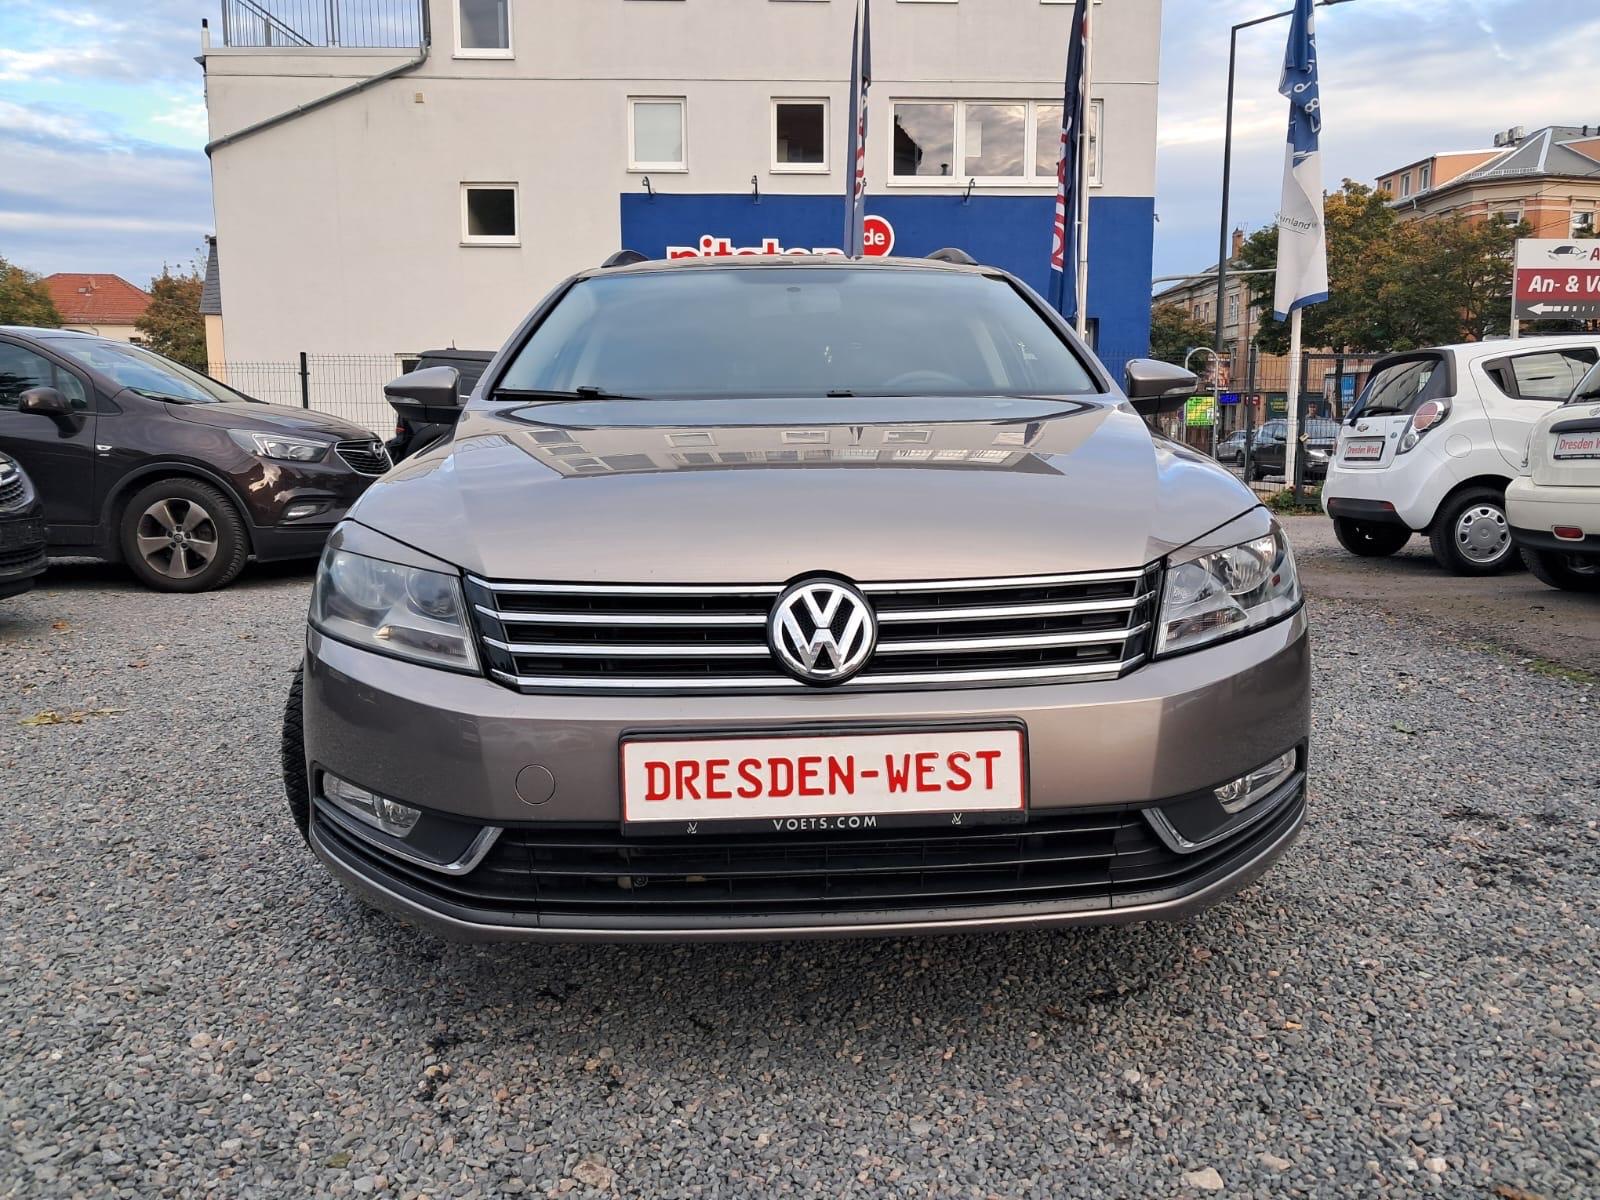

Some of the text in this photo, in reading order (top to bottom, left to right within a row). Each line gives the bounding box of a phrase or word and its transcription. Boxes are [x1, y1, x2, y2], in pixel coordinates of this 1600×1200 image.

[1528, 275, 1560, 293] An-
[1565, 275, 1579, 293] &
[1560, 437, 1593, 450] Dresden
[644, 750, 1001, 801] DRESDEN-WEST
[773, 815, 877, 831] VOETS.COM
